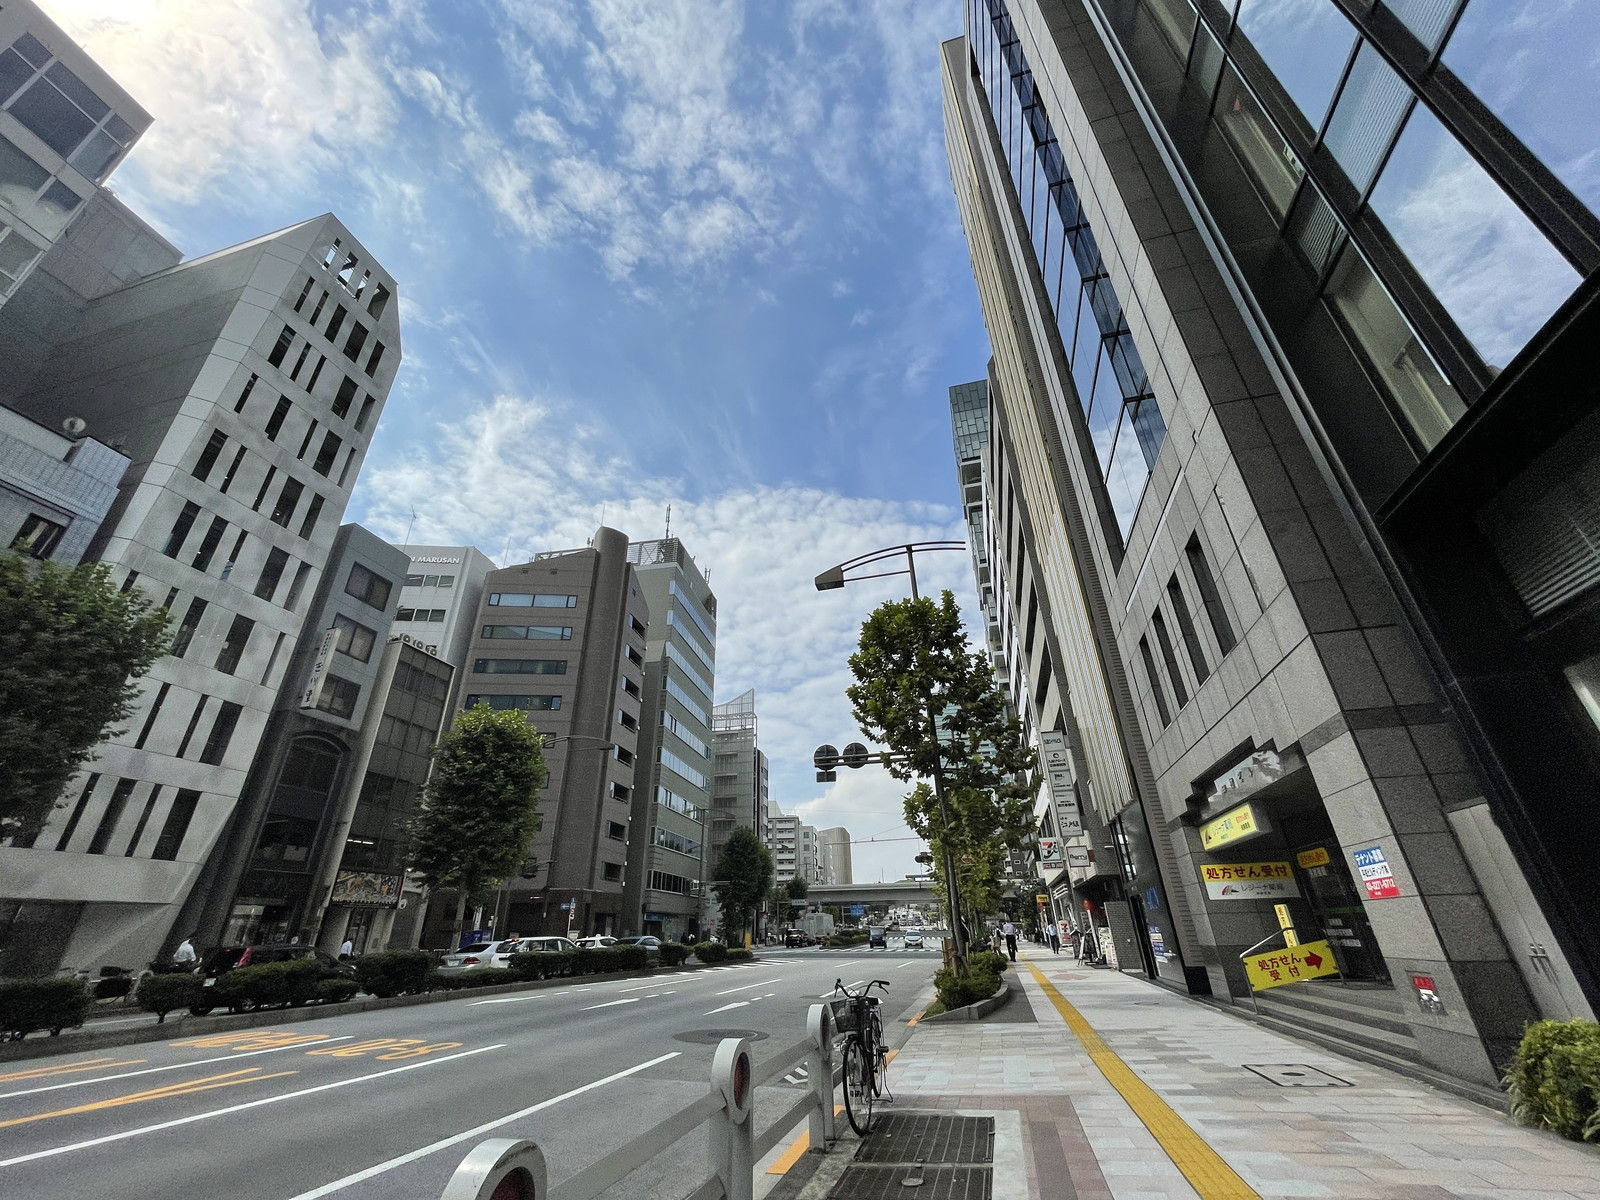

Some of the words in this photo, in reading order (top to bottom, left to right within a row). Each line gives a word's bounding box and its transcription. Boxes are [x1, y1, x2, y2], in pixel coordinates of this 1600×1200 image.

[417, 556, 460, 565] MARUSAN
[1206, 865, 1288, 879] 処方せん受付
[1258, 953, 1301, 971] 処方せん
